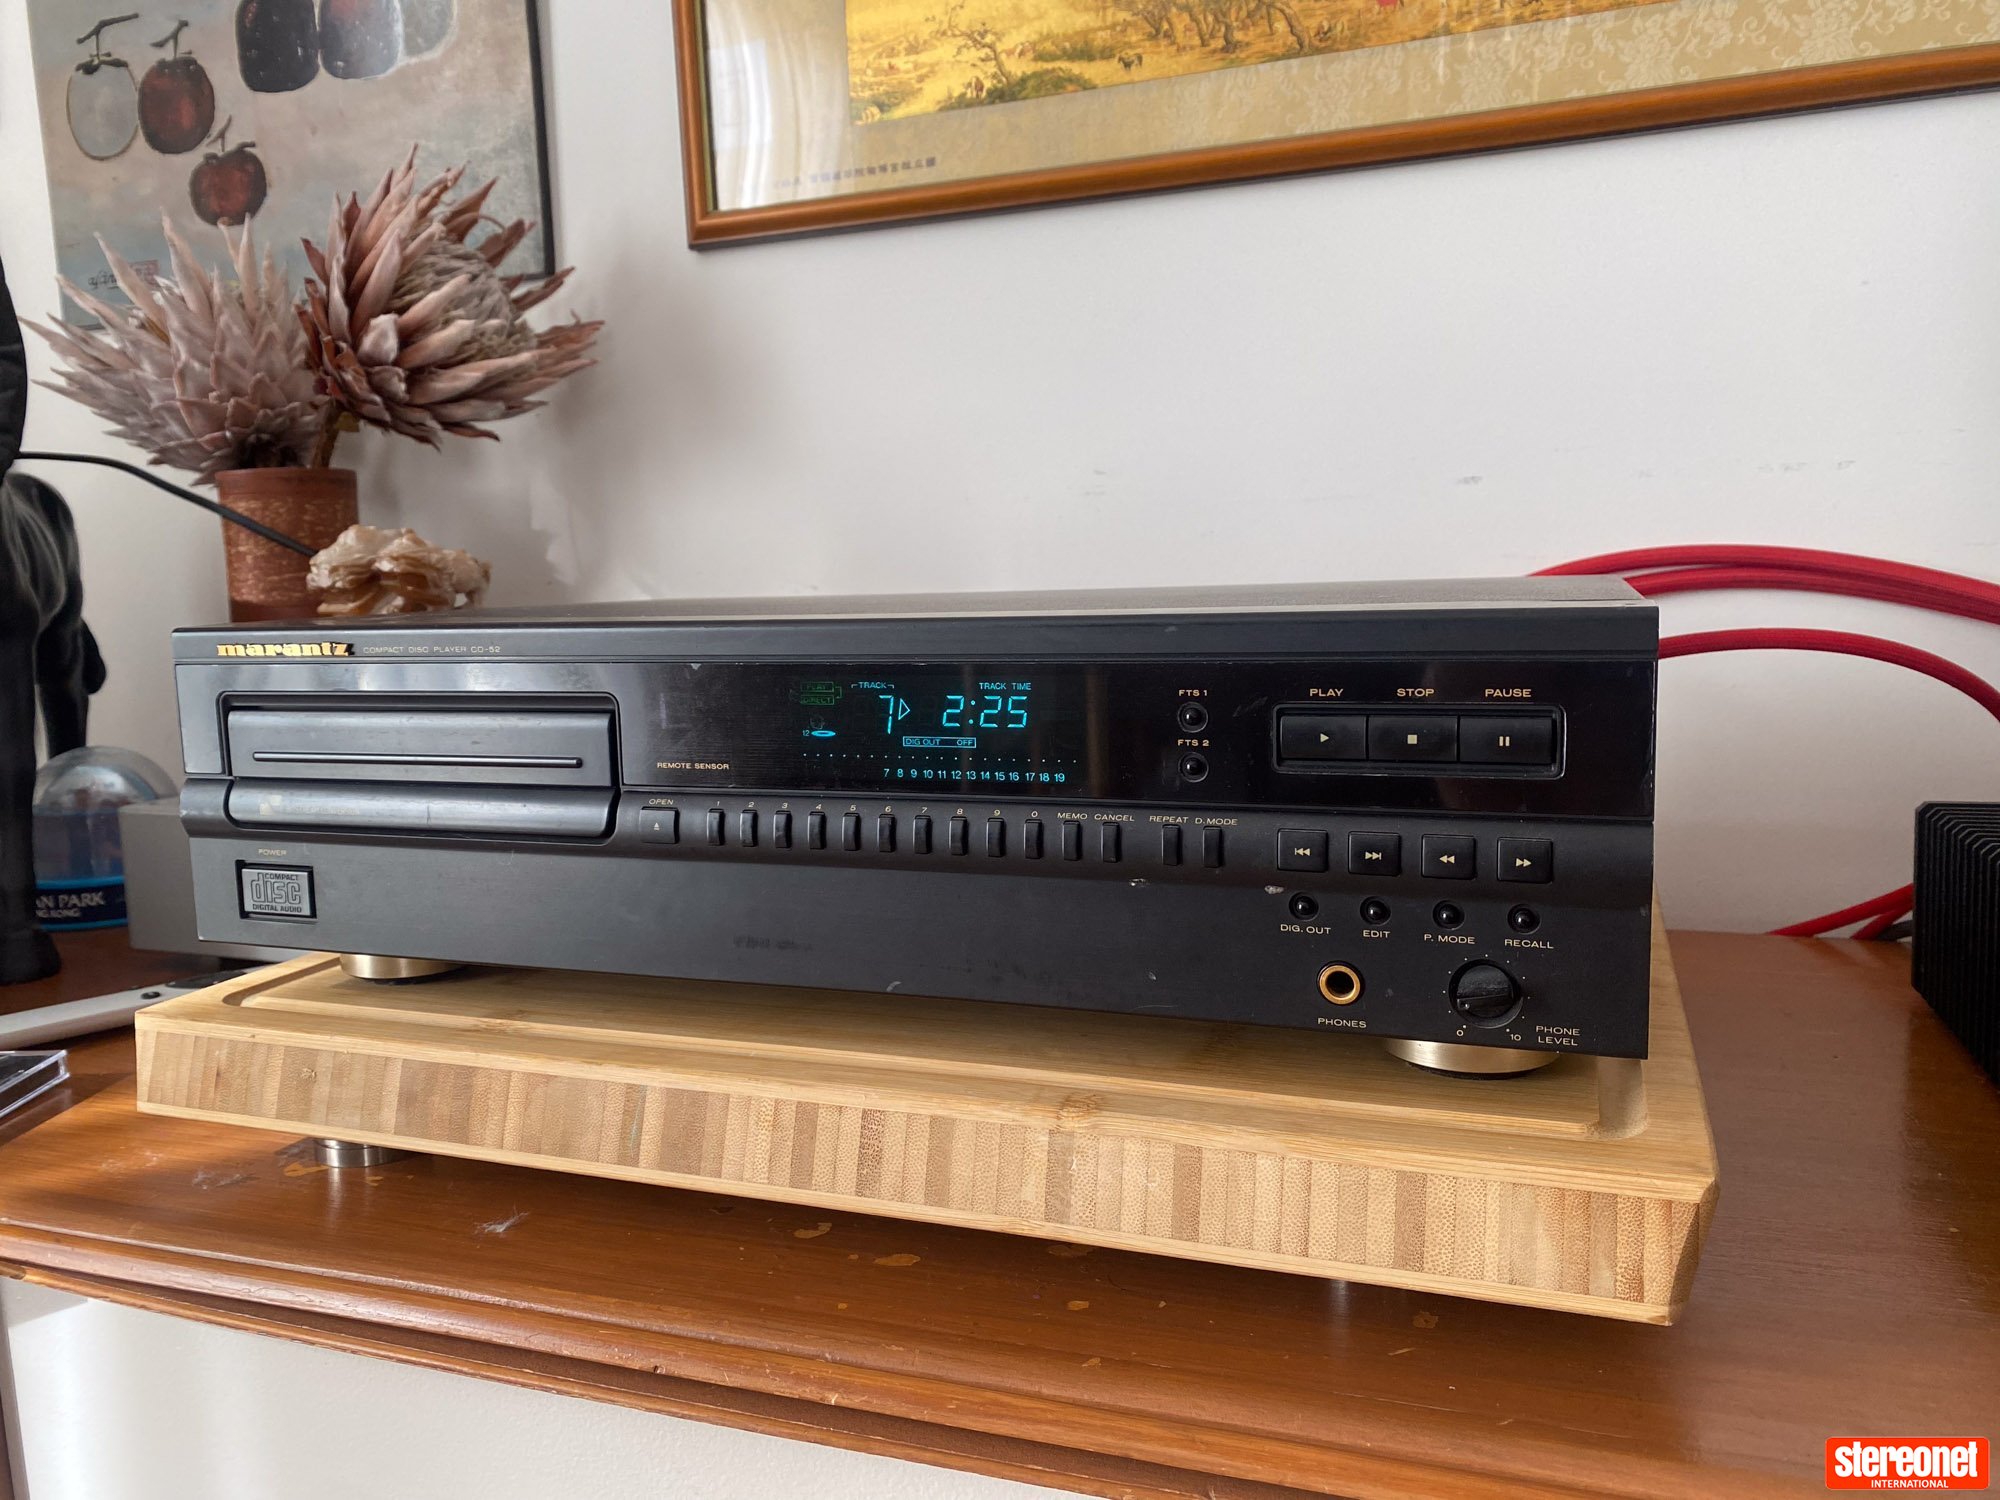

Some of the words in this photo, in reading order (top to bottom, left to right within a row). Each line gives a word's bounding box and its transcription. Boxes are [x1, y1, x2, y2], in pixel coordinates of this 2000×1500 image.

[216, 642, 349, 656] marantz
[363, 646, 405, 654] COMPACT
[470, 645, 501, 653] CD-52
[858, 681, 887, 689] TRACK
[979, 682, 1007, 690] TRACK
[1011, 682, 1032, 690] TIME
[1178, 689, 1200, 697] FTS
[1203, 689, 1208, 697] 1
[1309, 688, 1343, 697] PLAY
[1396, 688, 1435, 697] STOP
[1484, 688, 1532, 698] PAUSE
[878, 695, 894, 735] 7
[942, 695, 1028, 728] 2:25
[905, 738, 921, 746] DIG
[922, 738, 941, 746] OUT
[1177, 739, 1199, 747] FTS
[1202, 739, 1210, 747] 2
[656, 762, 692, 770] REMOTE
[694, 762, 730, 770] SENSOR
[883, 768, 890, 777] 7
[896, 768, 904, 778] 8
[910, 768, 918, 778] 9
[923, 769, 934, 779] 10
[938, 770, 947, 779] 11
[951, 770, 962, 780] 12
[966, 770, 977, 780] 13
[980, 771, 990, 780] 14
[994, 771, 1006, 781] 15
[1008, 772, 1020, 782] 16
[1025, 772, 1036, 782] 17
[1039, 773, 1050, 782] 18
[1054, 773, 1065, 783] 19
[648, 798, 674, 806] OPEN
[993, 809, 1001, 817] 9
[1057, 812, 1088, 820] MEMO
[1094, 813, 1135, 822] CANCEL
[1149, 815, 1189, 824] REPEAT
[258, 848, 287, 856] POWER
[264, 872, 299, 881] COMPACT
[58, 891, 105, 907] PARK
[252, 903, 279, 912] DIGITAL
[1280, 923, 1304, 933] DIG.
[1305, 926, 1332, 935] OUT
[1362, 929, 1391, 938] EDIT
[1424, 933, 1434, 942] P.
[1438, 934, 1476, 945] MODE
[1504, 939, 1554, 949] RECALL
[1317, 1017, 1367, 1029] PHONES
[1535, 1025, 1581, 1036] PHONE
[1538, 1036, 1578, 1046] LEVEL
